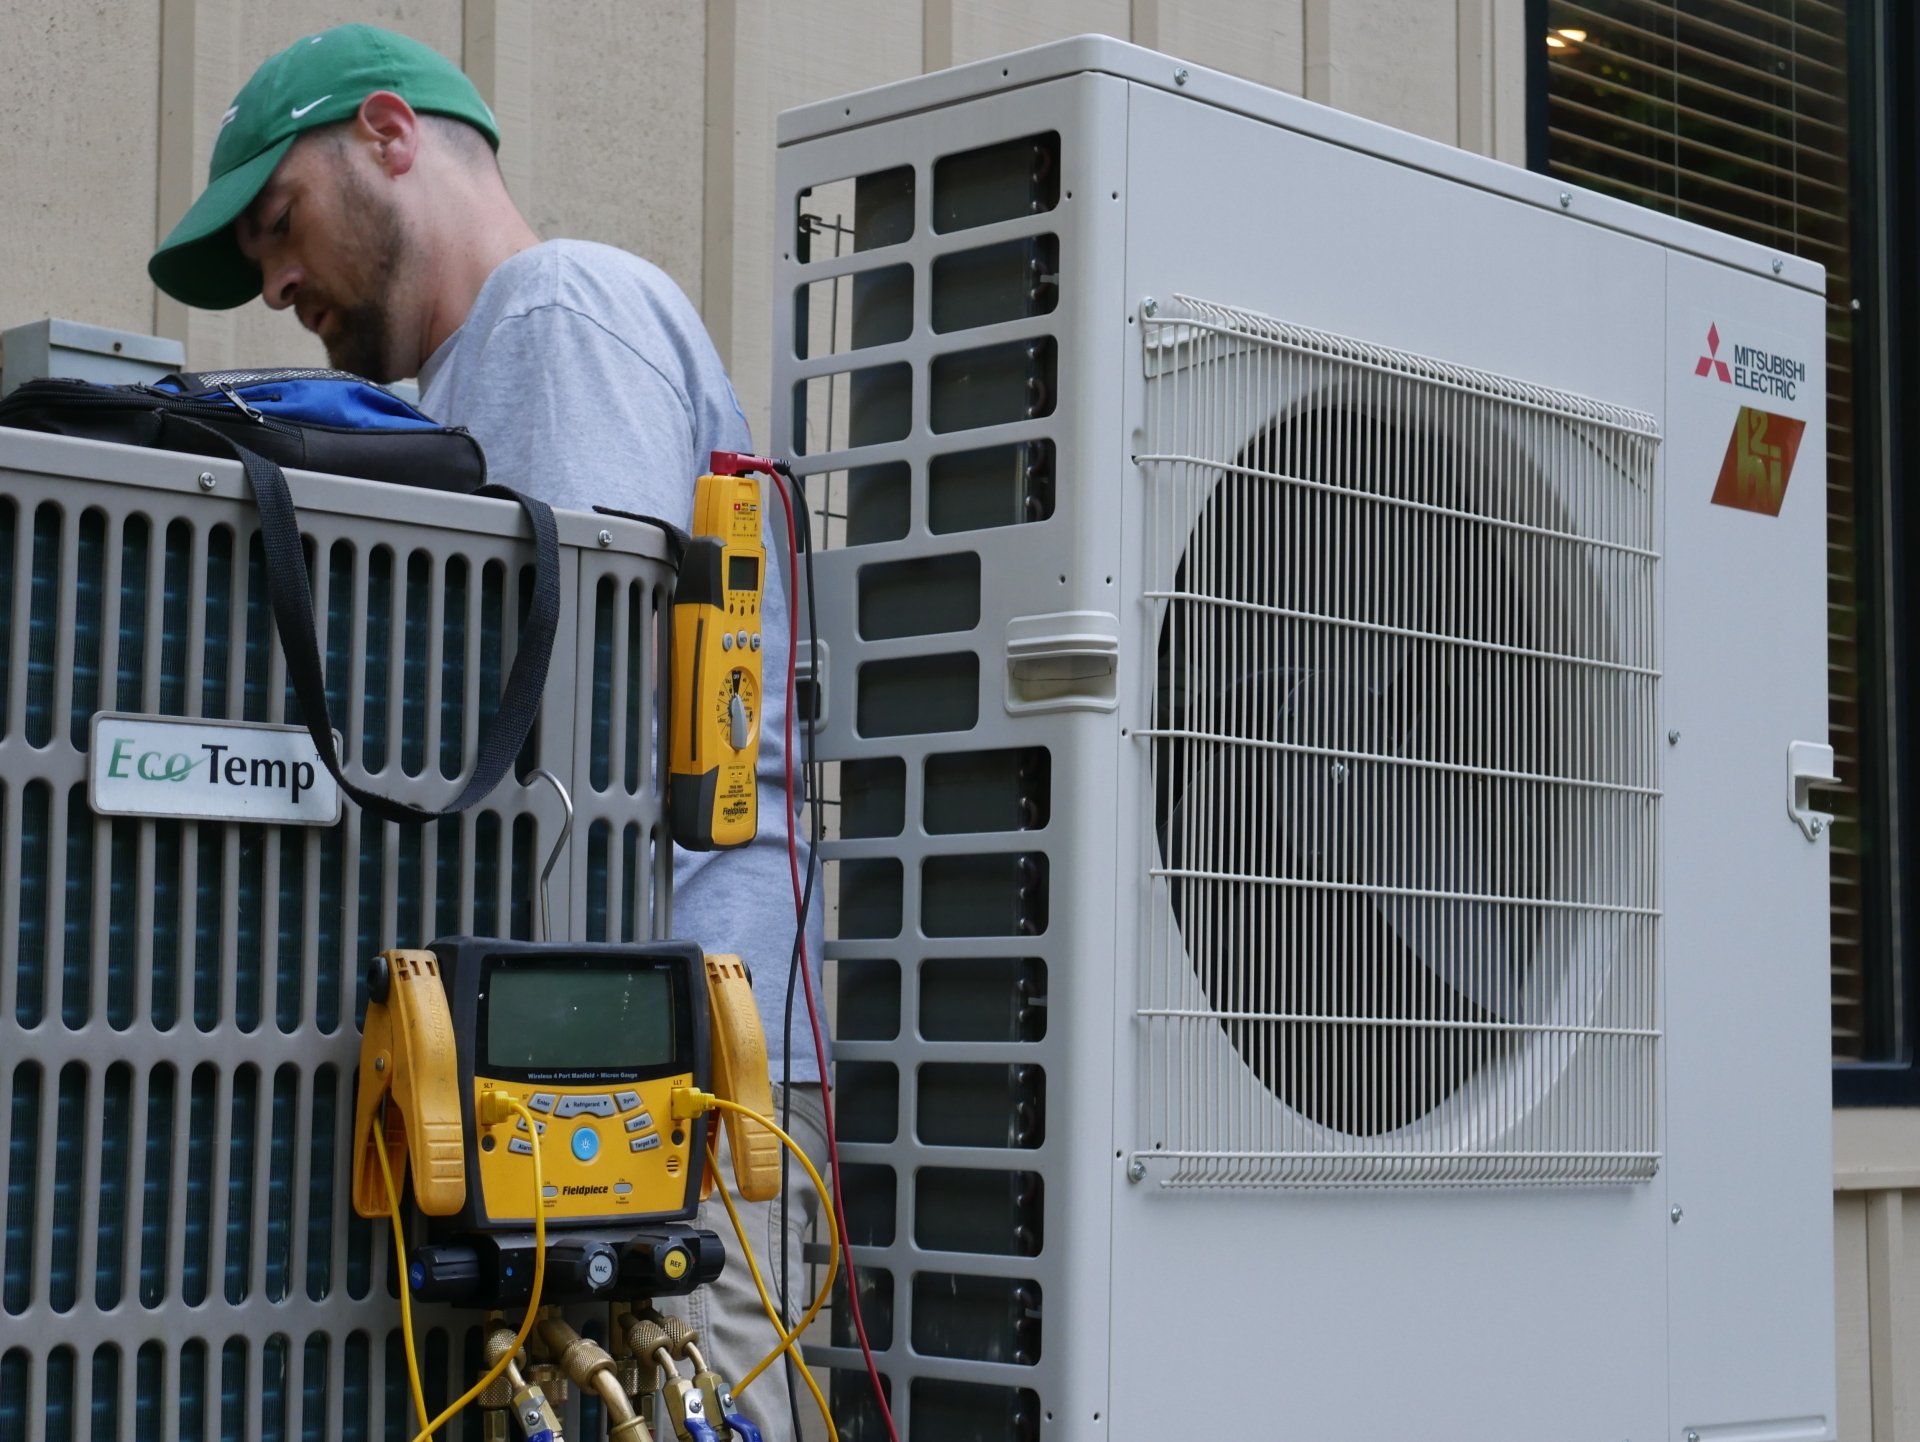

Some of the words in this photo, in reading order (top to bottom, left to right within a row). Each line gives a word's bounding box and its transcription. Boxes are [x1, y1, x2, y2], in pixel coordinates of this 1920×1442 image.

[1734, 344, 1805, 382] MITSUBISHI
[1734, 366, 1796, 401] ELECTRIC
[722, 805, 749, 816] Fieldpiece
[537, 1098, 550, 1107] Enter
[573, 1101, 600, 1109] Refrigerant
[633, 1120, 646, 1128] Units
[635, 1140, 650, 1149] Target
[562, 1185, 609, 1196] Fieldpiece
[669, 1260, 682, 1268] REF
[594, 1265, 608, 1273] VAC
